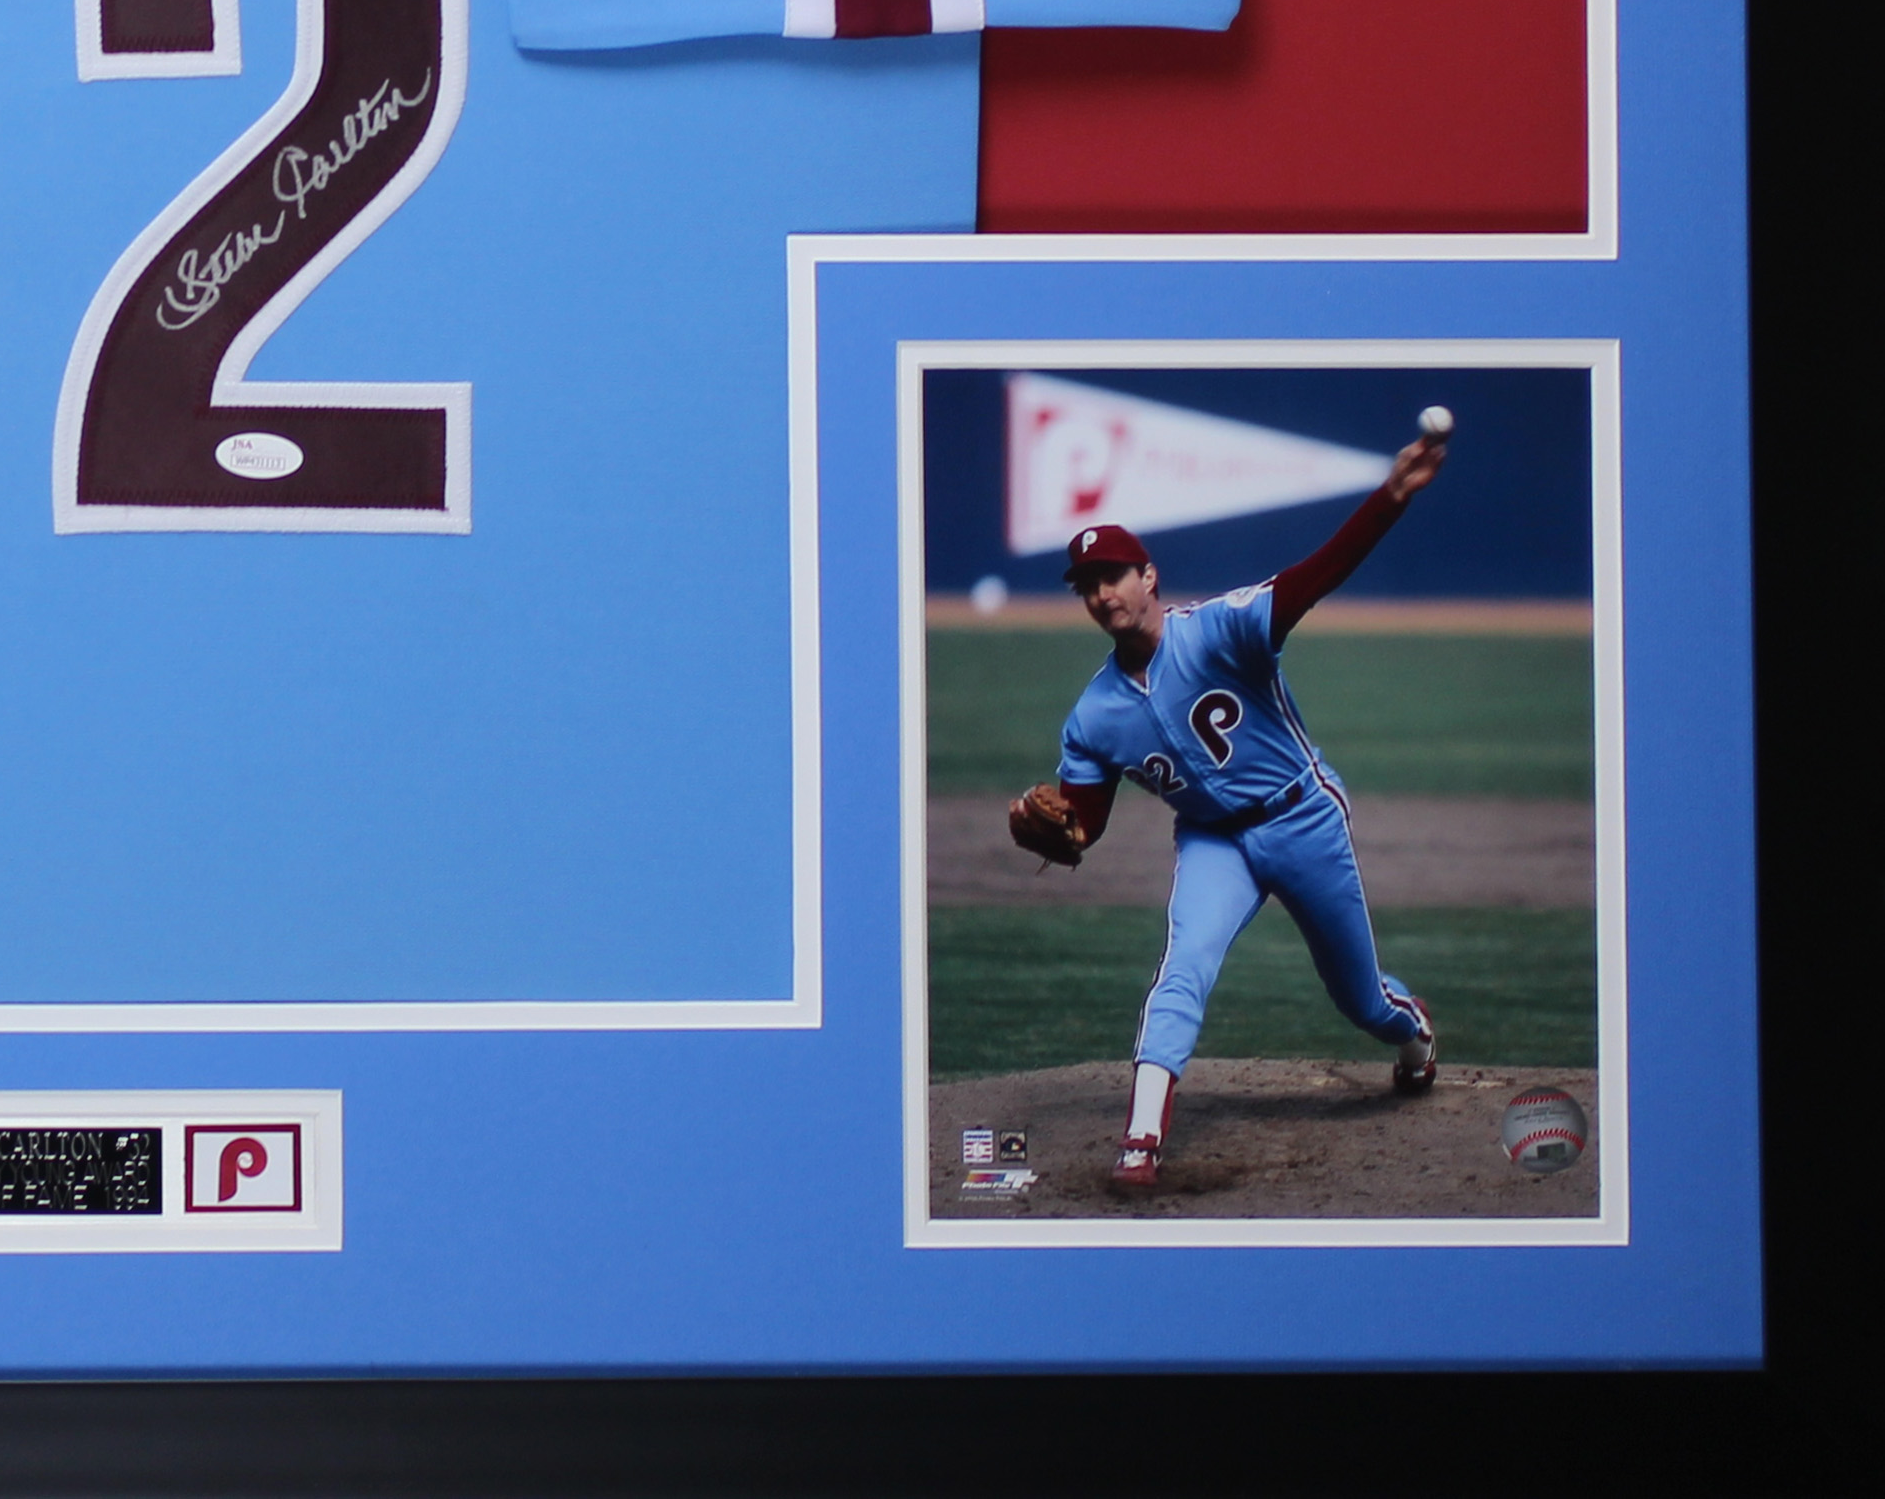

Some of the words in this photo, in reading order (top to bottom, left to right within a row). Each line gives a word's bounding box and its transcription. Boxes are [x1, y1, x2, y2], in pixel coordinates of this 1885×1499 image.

[1081, 530, 1098, 554] P
[1188, 689, 1244, 770] P
[116, 1132, 150, 1160] #32
[218, 1137, 268, 1202] P
[23, 1184, 89, 1210] FAME
[103, 1184, 151, 1210] 1994
